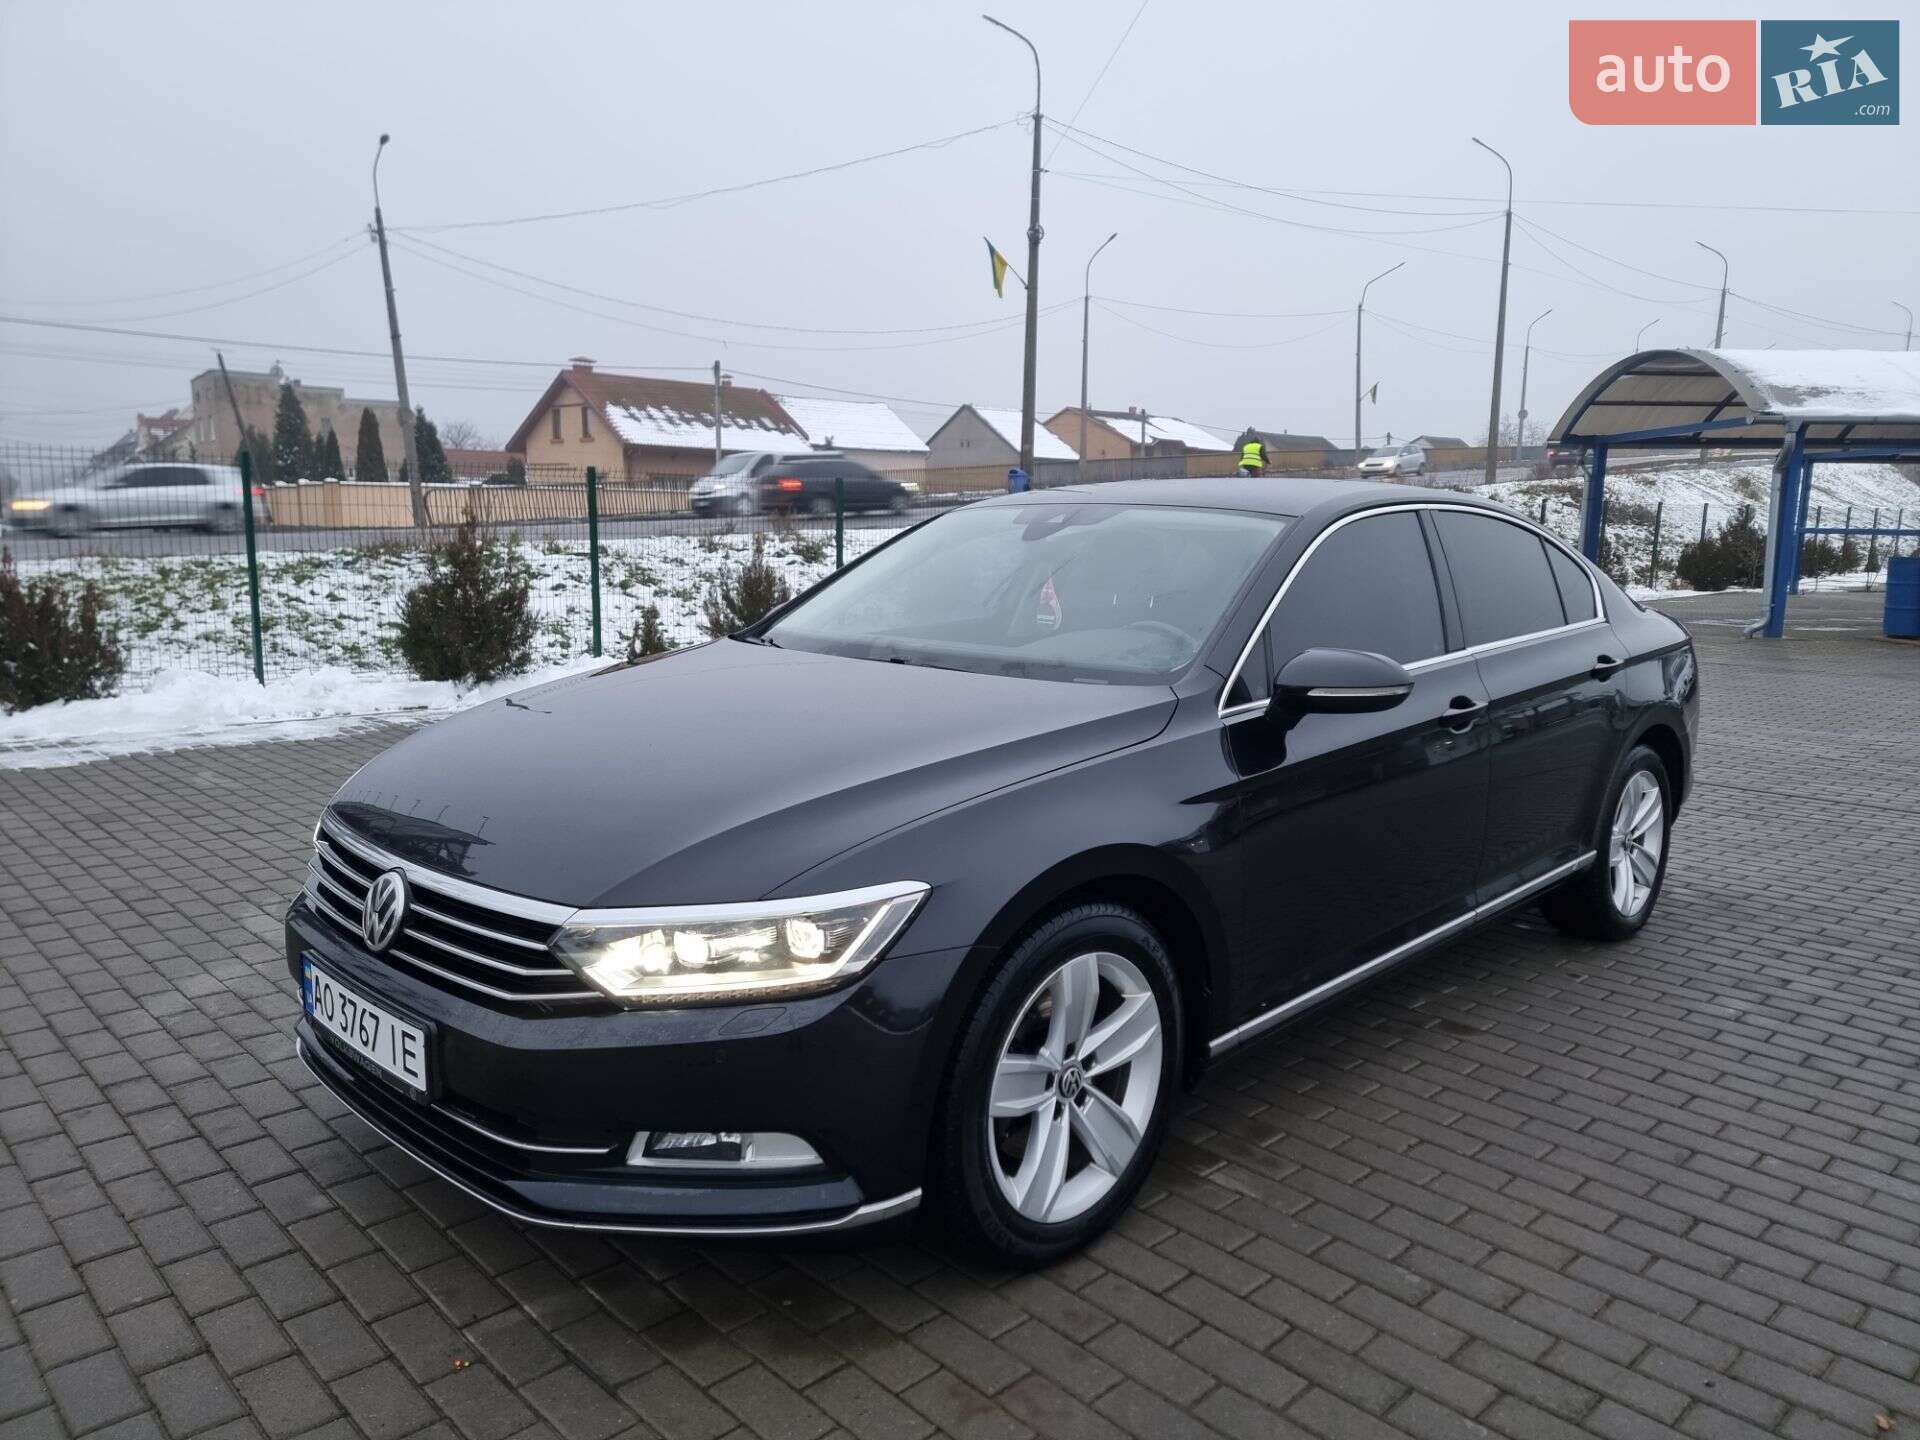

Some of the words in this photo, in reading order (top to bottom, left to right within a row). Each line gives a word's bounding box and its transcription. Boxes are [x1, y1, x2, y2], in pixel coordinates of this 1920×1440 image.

[314, 975, 335, 1022] AO
[338, 991, 380, 1052] 3767
[391, 1023, 419, 1079] IE
